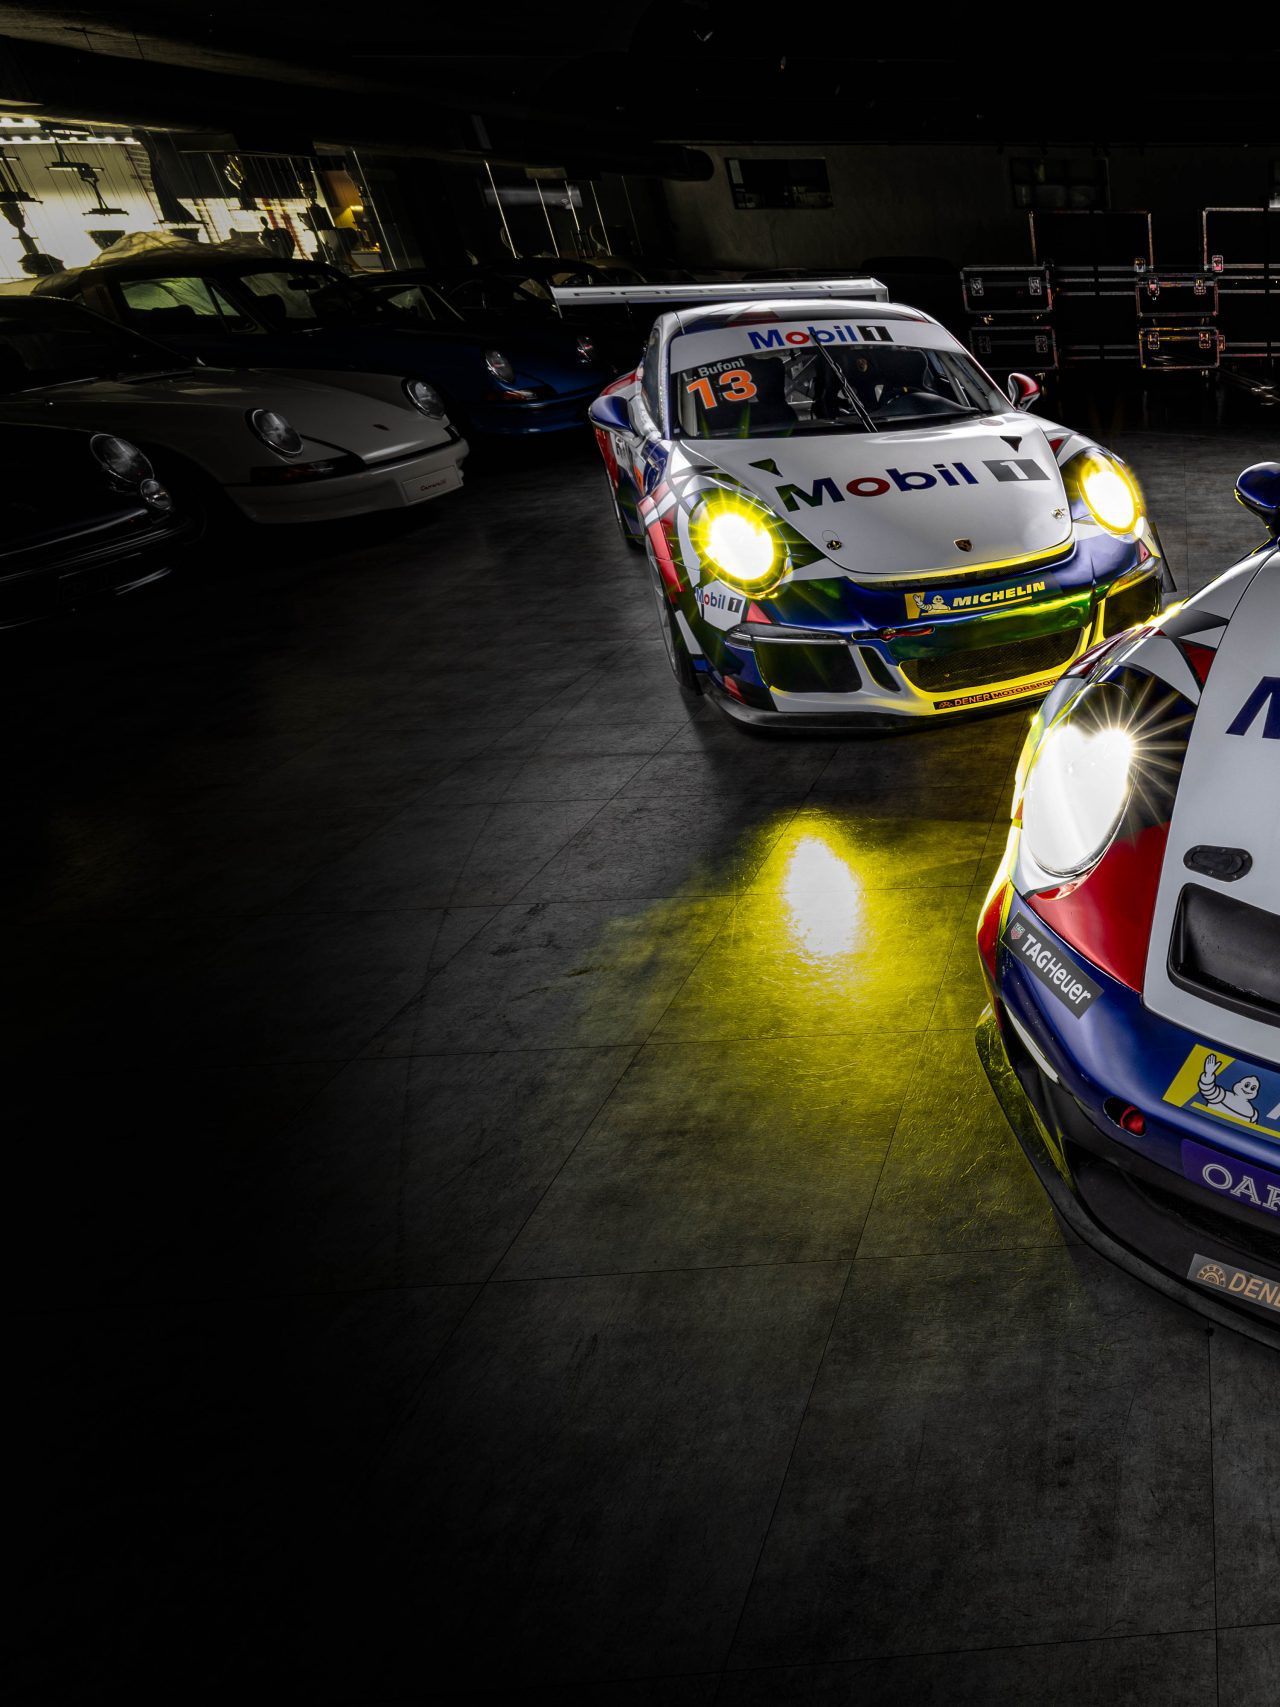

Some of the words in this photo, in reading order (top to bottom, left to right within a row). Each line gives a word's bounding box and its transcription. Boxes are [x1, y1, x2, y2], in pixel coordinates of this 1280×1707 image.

[747, 325, 859, 350] Mobil
[682, 372, 697, 382] L.
[698, 358, 746, 378] Bufoni
[686, 369, 757, 410] 13
[775, 461, 979, 512] Mobil
[695, 586, 726, 610] Mobil
[952, 581, 1046, 607] MICHELIN
[954, 693, 990, 706] DENER
[992, 679, 1057, 699] MOTORSPOR
